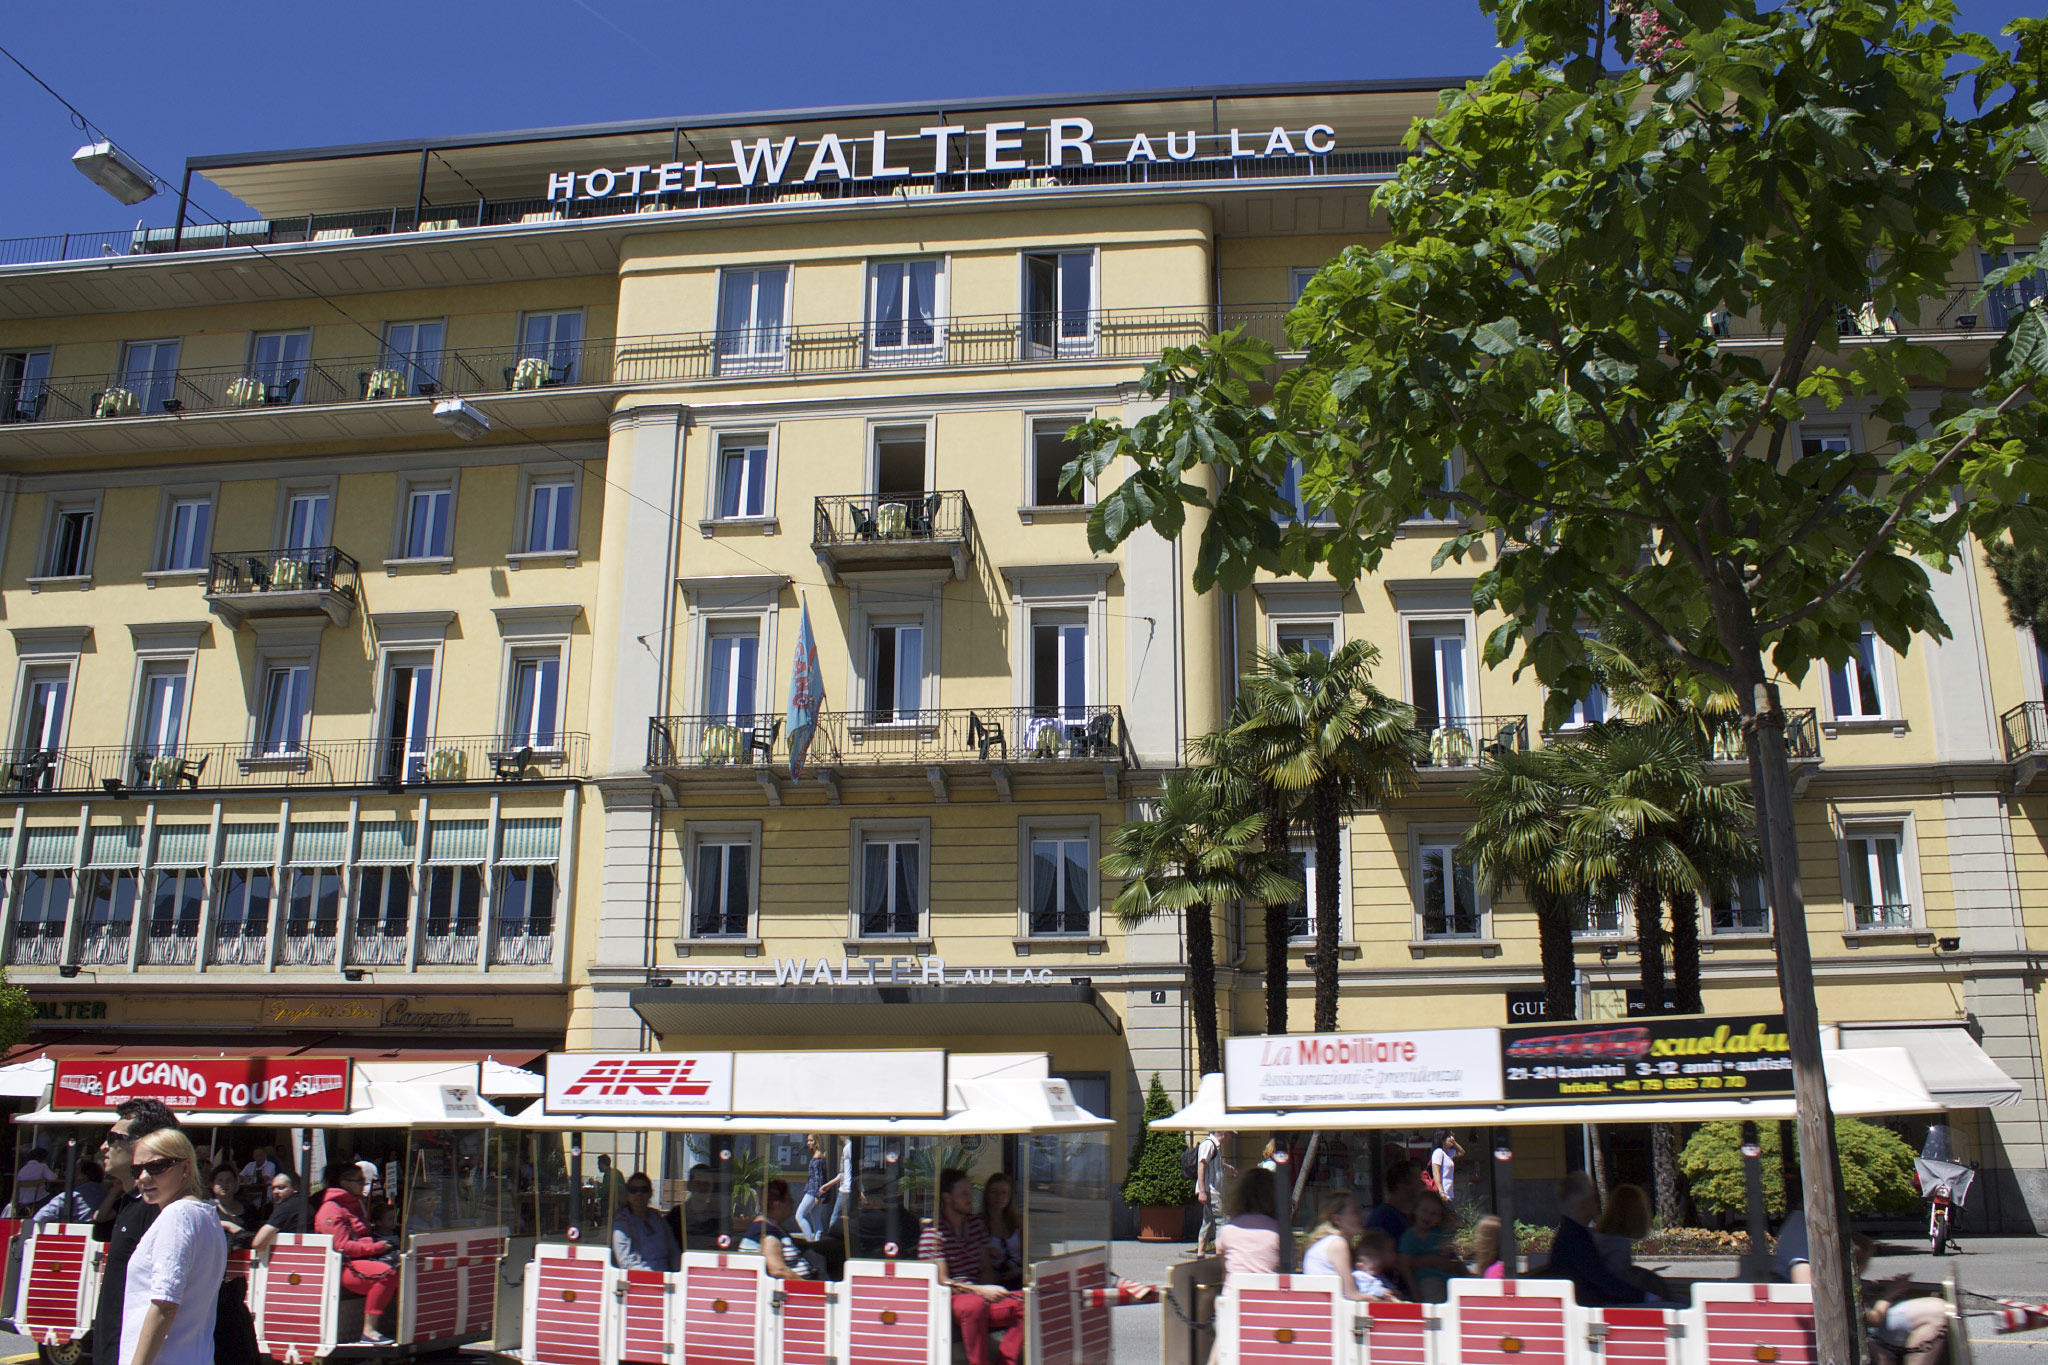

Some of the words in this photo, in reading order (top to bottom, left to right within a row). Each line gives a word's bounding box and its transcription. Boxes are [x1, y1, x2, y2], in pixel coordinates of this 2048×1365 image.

[547, 160, 717, 201] HOTEL
[731, 117, 1095, 186] WALTER
[1126, 130, 1196, 163] AU
[1230, 124, 1336, 160] LAC
[686, 970, 761, 986] HOTEL
[774, 957, 945, 985] WALTER
[962, 969, 993, 985] AU
[1007, 968, 1053, 985] LAC
[1155, 991, 1161, 1001] 7
[1512, 1001, 1547, 1016] GUE
[1259, 1040, 1292, 1066] La
[1298, 1037, 1417, 1065] Mobiliare
[1650, 1023, 1790, 1057] scuolabu
[563, 1060, 712, 1095] ARL
[1557, 1064, 1626, 1078] bambini
[1681, 1060, 1722, 1073] anni
[1735, 1058, 1792, 1071] autist
[106, 1062, 207, 1097] LUGANO
[215, 1075, 288, 1106] TOUR
